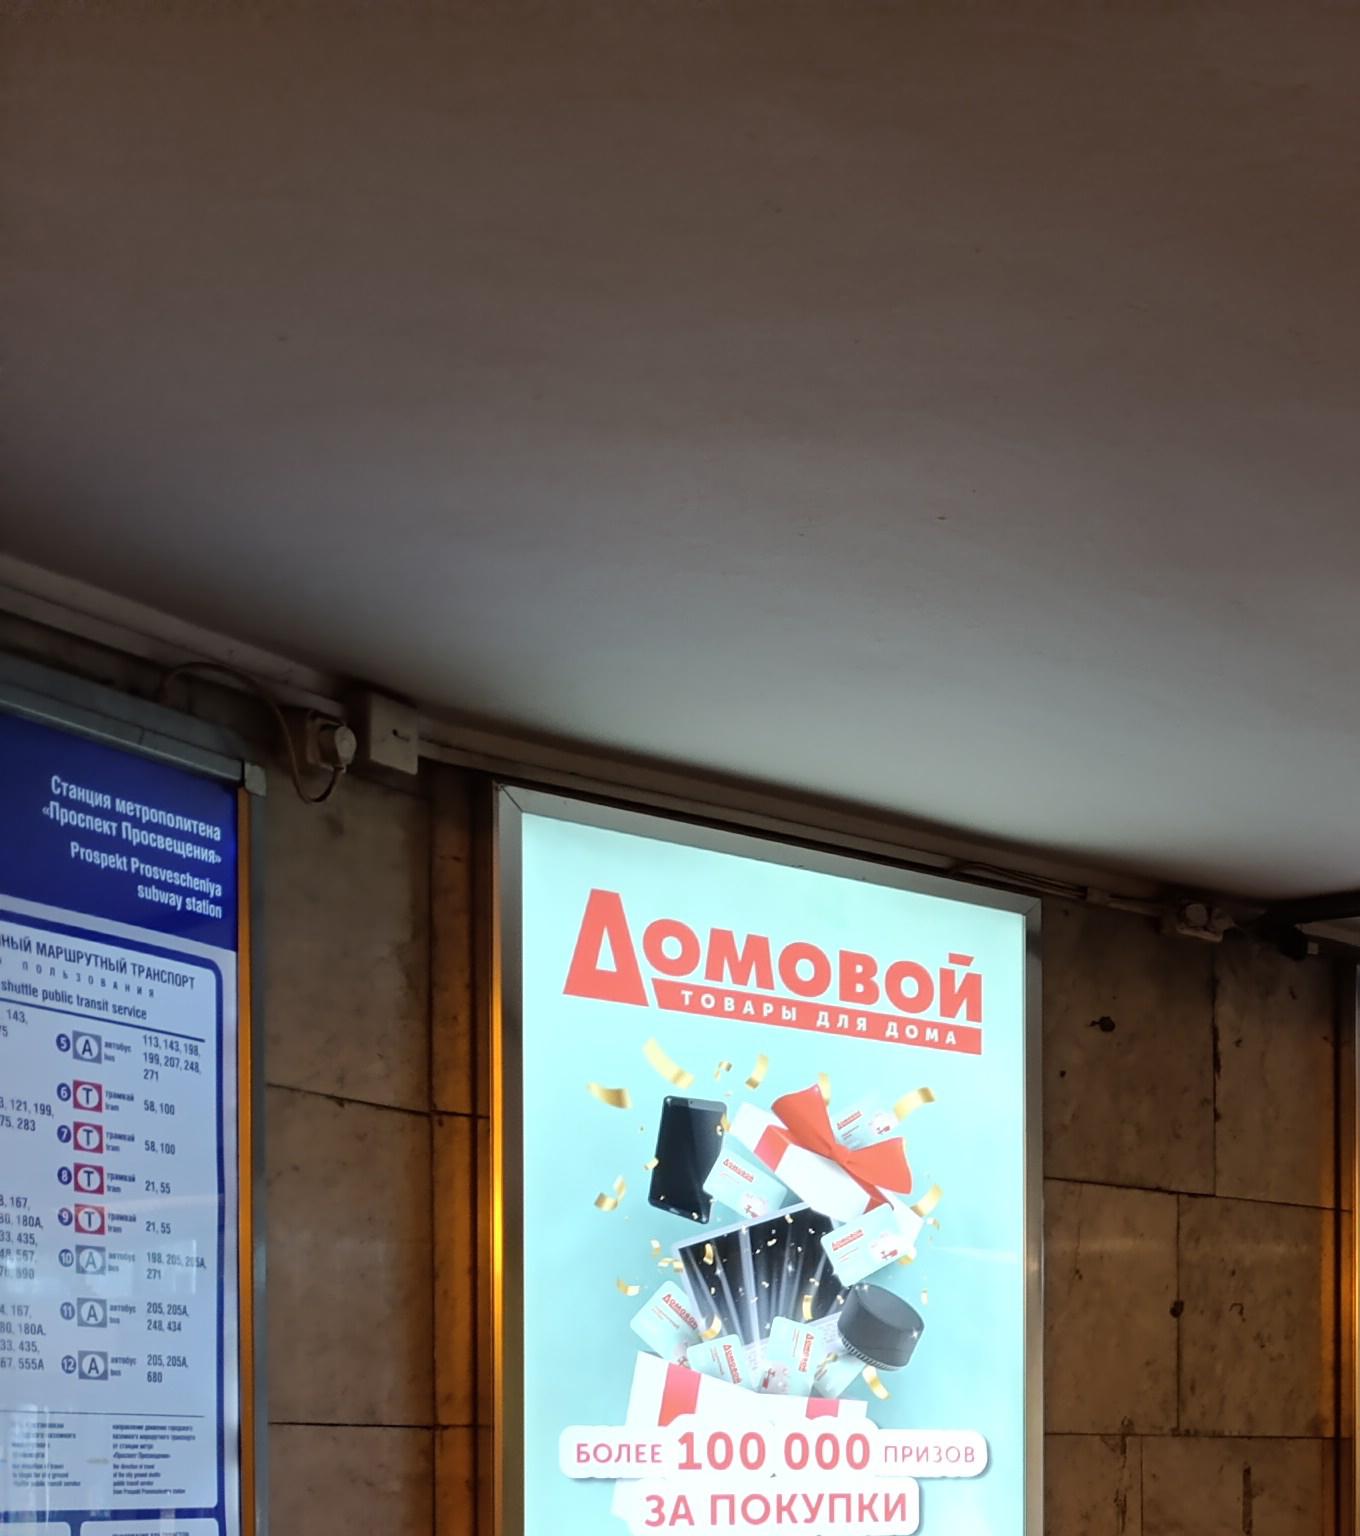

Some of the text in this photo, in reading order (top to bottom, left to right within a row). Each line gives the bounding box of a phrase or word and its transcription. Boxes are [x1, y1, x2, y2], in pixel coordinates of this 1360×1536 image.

[51, 775, 221, 842] Станция метрополитена
[42, 801, 222, 865] «Проспект Просвещения»
[71, 842, 222, 898] Prospekt Prosvescheniya
[138, 884, 222, 920] subway station
[36, 941, 127, 972] МАРШРУТНЫЙ
[130, 962, 195, 991] ТРАНСПОРТ
[1, 980, 147, 1020] shuttle public transit service
[681, 990, 958, 1046] ТОВАРЫ ДЛЯ ДОМА
[144, 1069, 159, 1081] 271
[17, 1117, 36, 1132] 283
[160, 1103, 175, 1116] 100
[160, 1142, 176, 1155] 100
[160, 1182, 171, 1194] 55
[161, 1222, 171, 1234] 55
[167, 1321, 182, 1333] 434
[147, 1372, 162, 1383] 680
[576, 1431, 975, 1471] БОЛЕЕ 100 000 ПРИЗОВ
[644, 1492, 907, 1527] ЗА ПОКУПКИ
